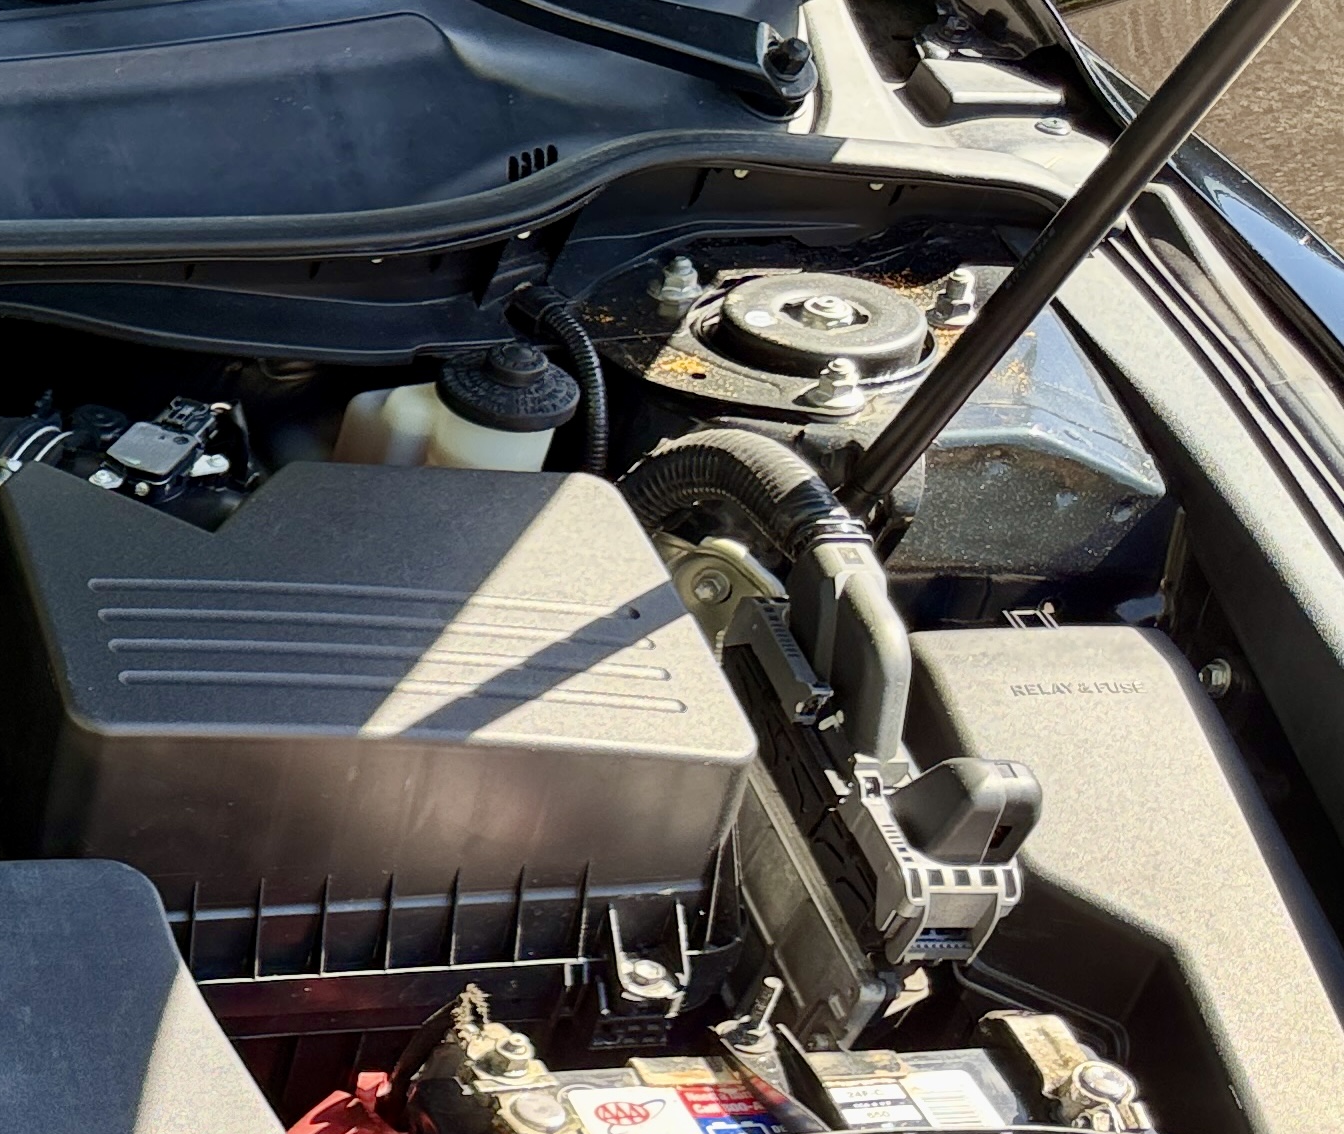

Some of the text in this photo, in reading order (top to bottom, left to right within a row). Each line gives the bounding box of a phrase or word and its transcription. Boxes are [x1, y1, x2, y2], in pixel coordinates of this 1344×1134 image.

[1009, 682, 1072, 697] RELAY
[1094, 680, 1148, 695] FUSE
[596, 1102, 650, 1126] AAA
